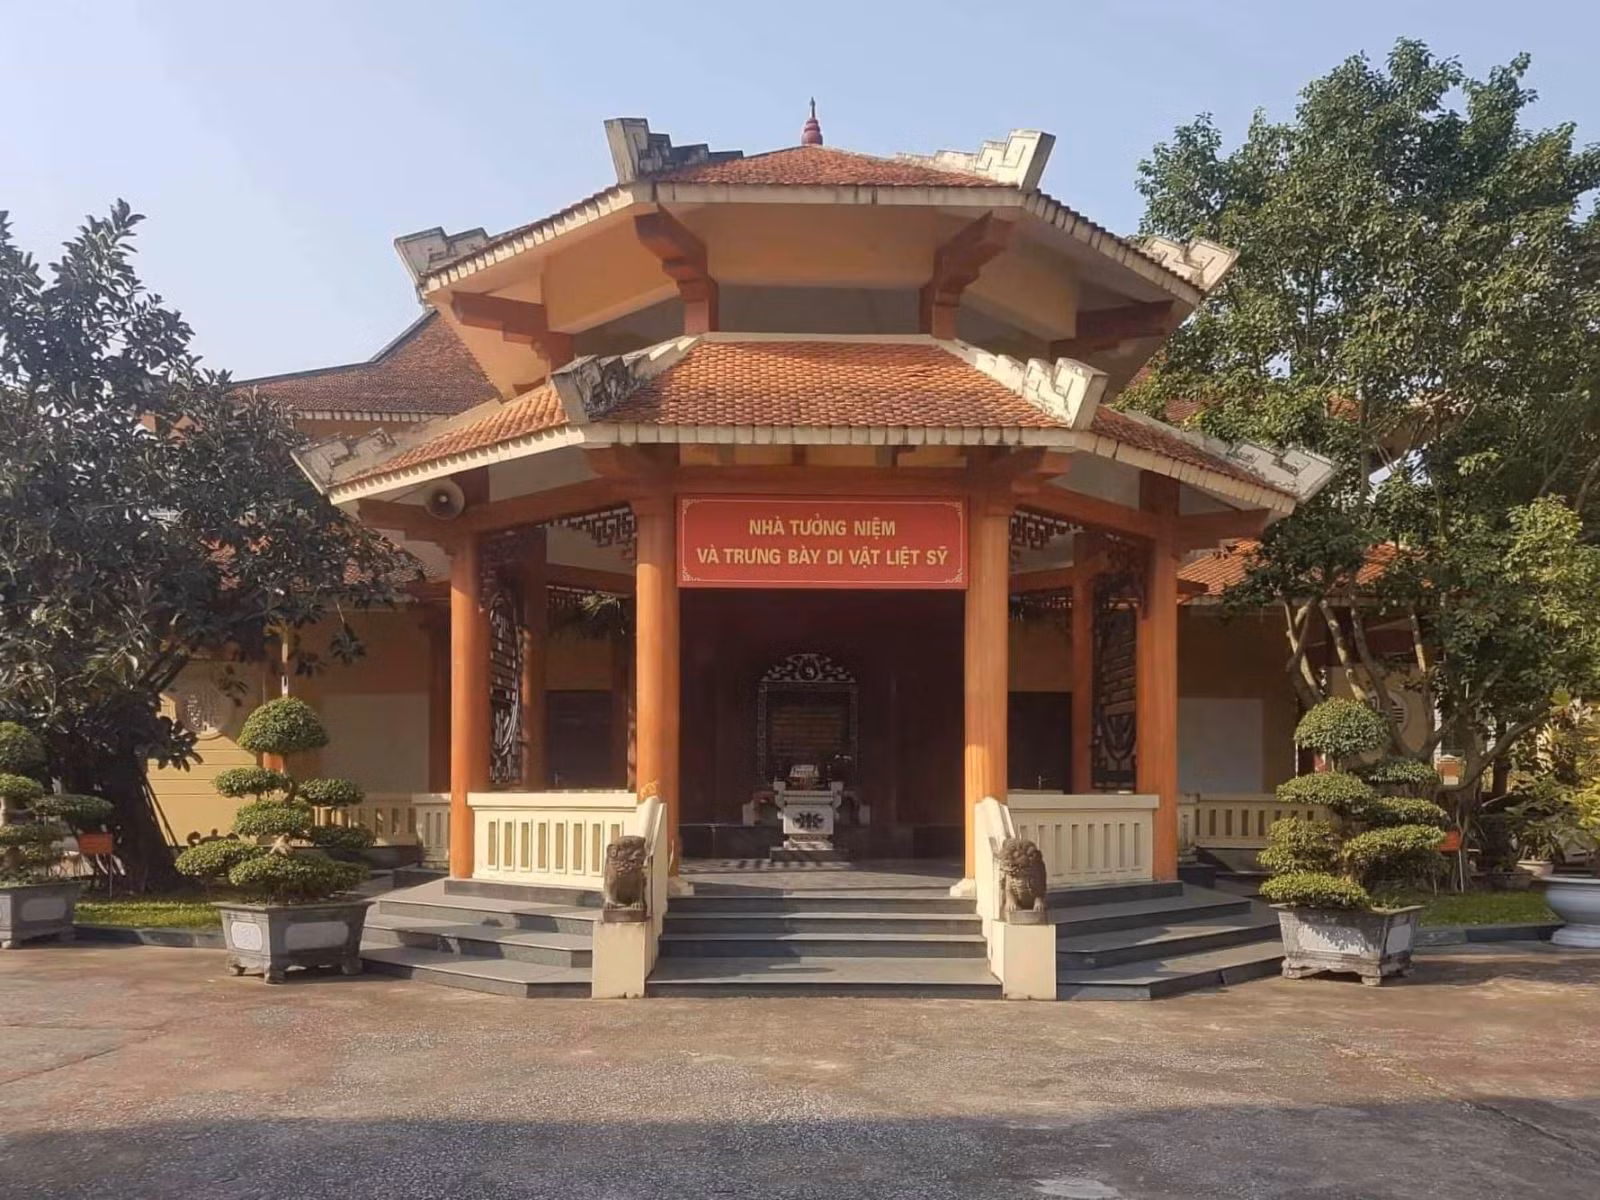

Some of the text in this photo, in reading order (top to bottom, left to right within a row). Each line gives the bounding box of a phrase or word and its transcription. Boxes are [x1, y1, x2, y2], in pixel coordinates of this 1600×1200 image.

[749, 512, 896, 540] NHÀ TƯỞNG NIỆM
[696, 543, 948, 569] VÀ TRƯNG BÀY DI VẬT LIỆT SỸ
